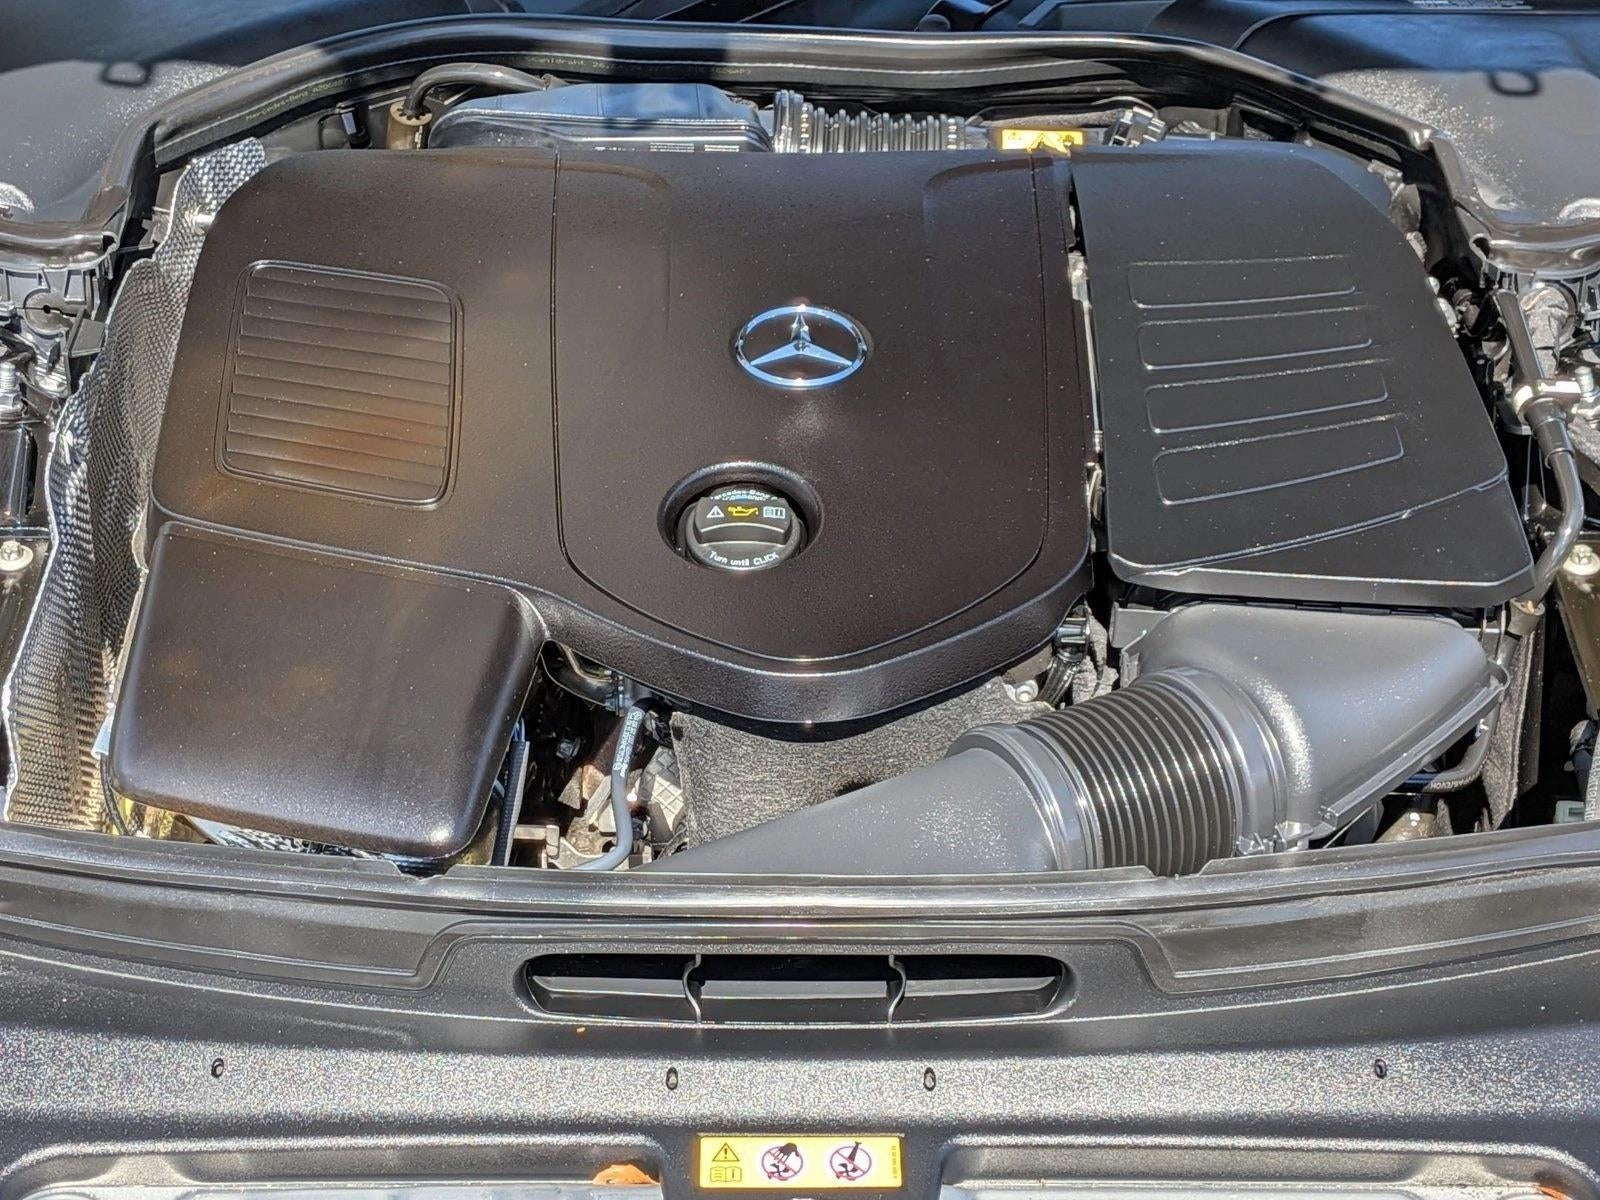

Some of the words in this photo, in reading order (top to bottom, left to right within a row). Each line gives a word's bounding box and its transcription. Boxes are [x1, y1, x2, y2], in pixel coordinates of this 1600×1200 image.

[710, 490, 771, 501] ercedes-Benz
[709, 550, 728, 564] Turn
[730, 558, 750, 566] until
[753, 551, 780, 565] CLICK
